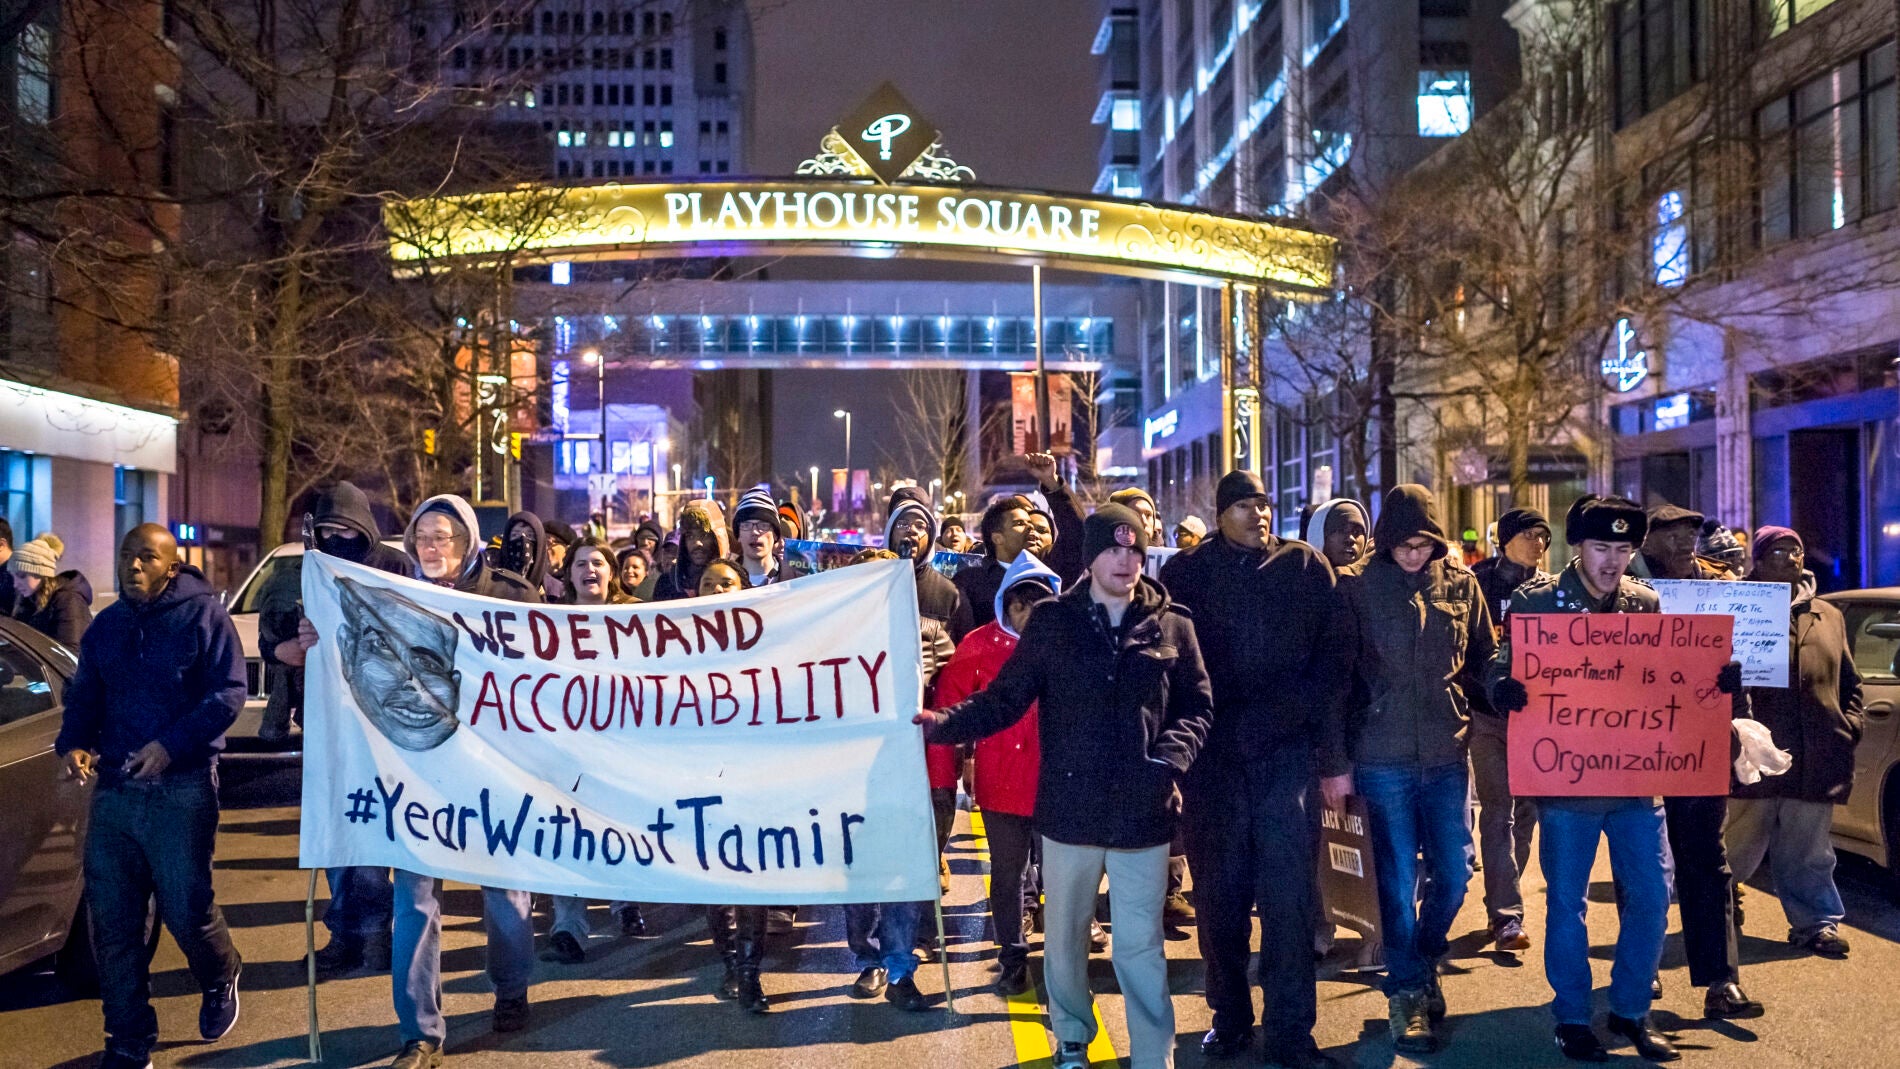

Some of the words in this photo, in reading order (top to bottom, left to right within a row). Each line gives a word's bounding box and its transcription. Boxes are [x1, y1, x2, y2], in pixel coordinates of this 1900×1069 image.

[665, 191, 919, 231] PLAYHOUSE
[937, 197, 1100, 241] SQUARE
[789, 560, 823, 572] POLICE
[1659, 587, 1678, 600] AR
[453, 610, 525, 660] WE
[527, 607, 764, 661] DEMAND
[1515, 616, 1559, 645] The
[1568, 616, 1664, 648] Cleveland
[1671, 617, 1724, 649] Police
[1525, 652, 1625, 687] Department
[1642, 667, 1656, 684] is
[1670, 671, 1685, 684] a
[470, 650, 887, 733] ACCOUNTABILITY
[1539, 693, 1681, 732] Terrorist
[1533, 740, 1706, 785] Organization!
[1321, 808, 1340, 830] LACK
[1344, 814, 1363, 836] LIVES
[1333, 848, 1360, 872] MATTER
